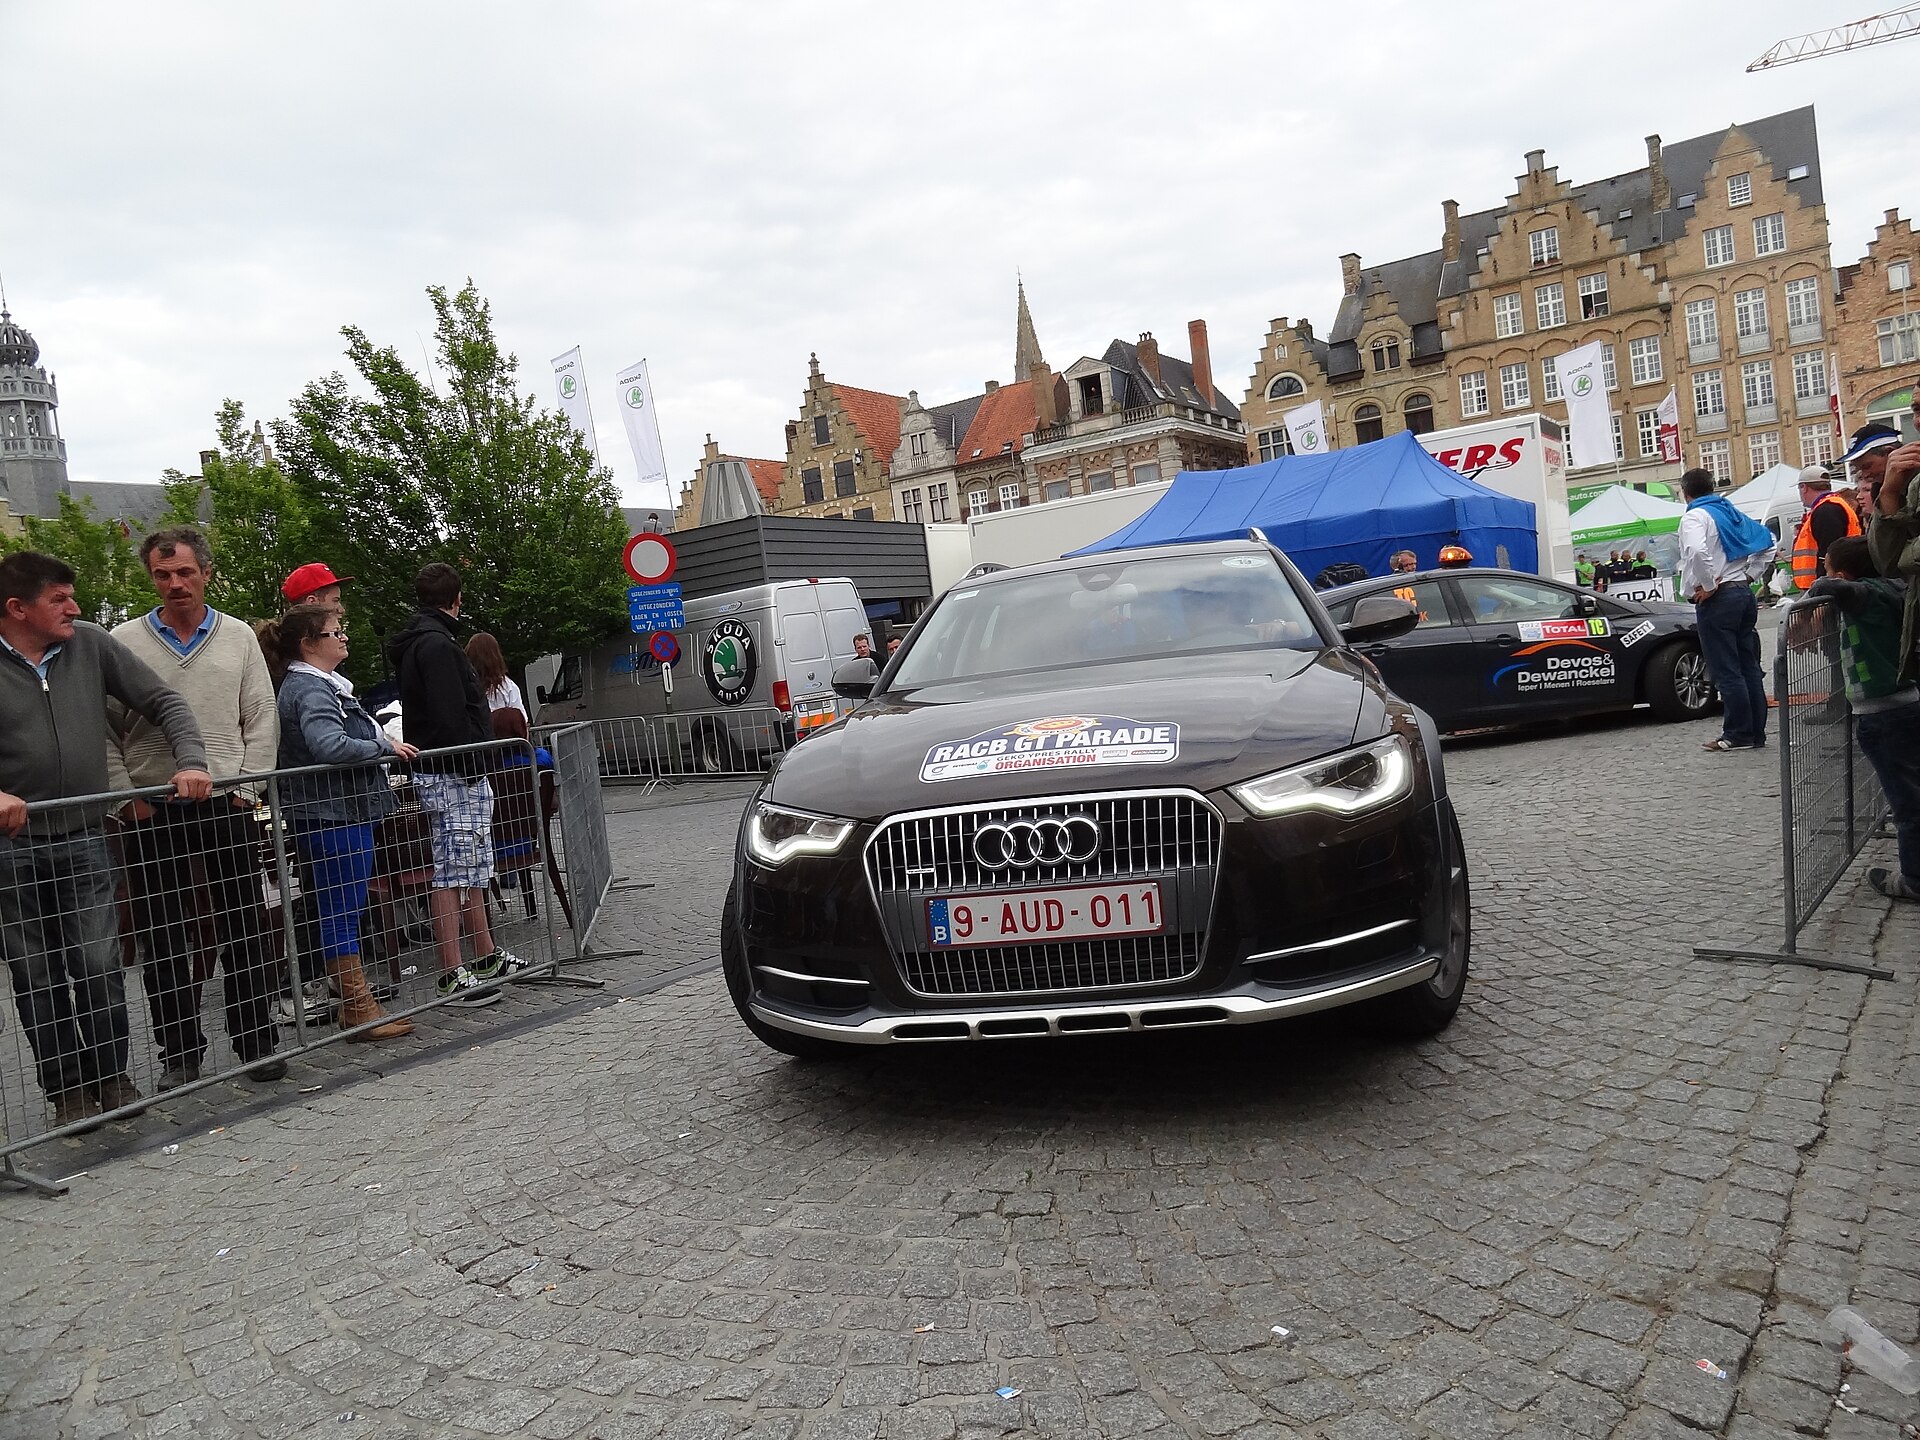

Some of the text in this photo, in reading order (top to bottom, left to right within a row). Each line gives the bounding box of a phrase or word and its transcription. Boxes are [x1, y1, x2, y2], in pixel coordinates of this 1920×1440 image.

[1430, 438, 1525, 471] ERS
[639, 602, 676, 610] UITGEZONDERD
[631, 613, 648, 621] LADEN
[1588, 619, 1604, 635] TC
[1622, 622, 1652, 646] SAFETY
[1518, 665, 1615, 684] Dewanckel
[718, 687, 747, 701] AUTO
[1518, 684, 1538, 692] Ieper
[1544, 681, 1570, 690] Menen
[933, 727, 1170, 763] RACB GT PARADE
[995, 754, 1097, 770] ORGANISATION
[996, 753, 1025, 761] GEKO
[1028, 751, 1062, 759] YPRES
[1064, 748, 1097, 756] RALLY
[934, 926, 947, 941] B
